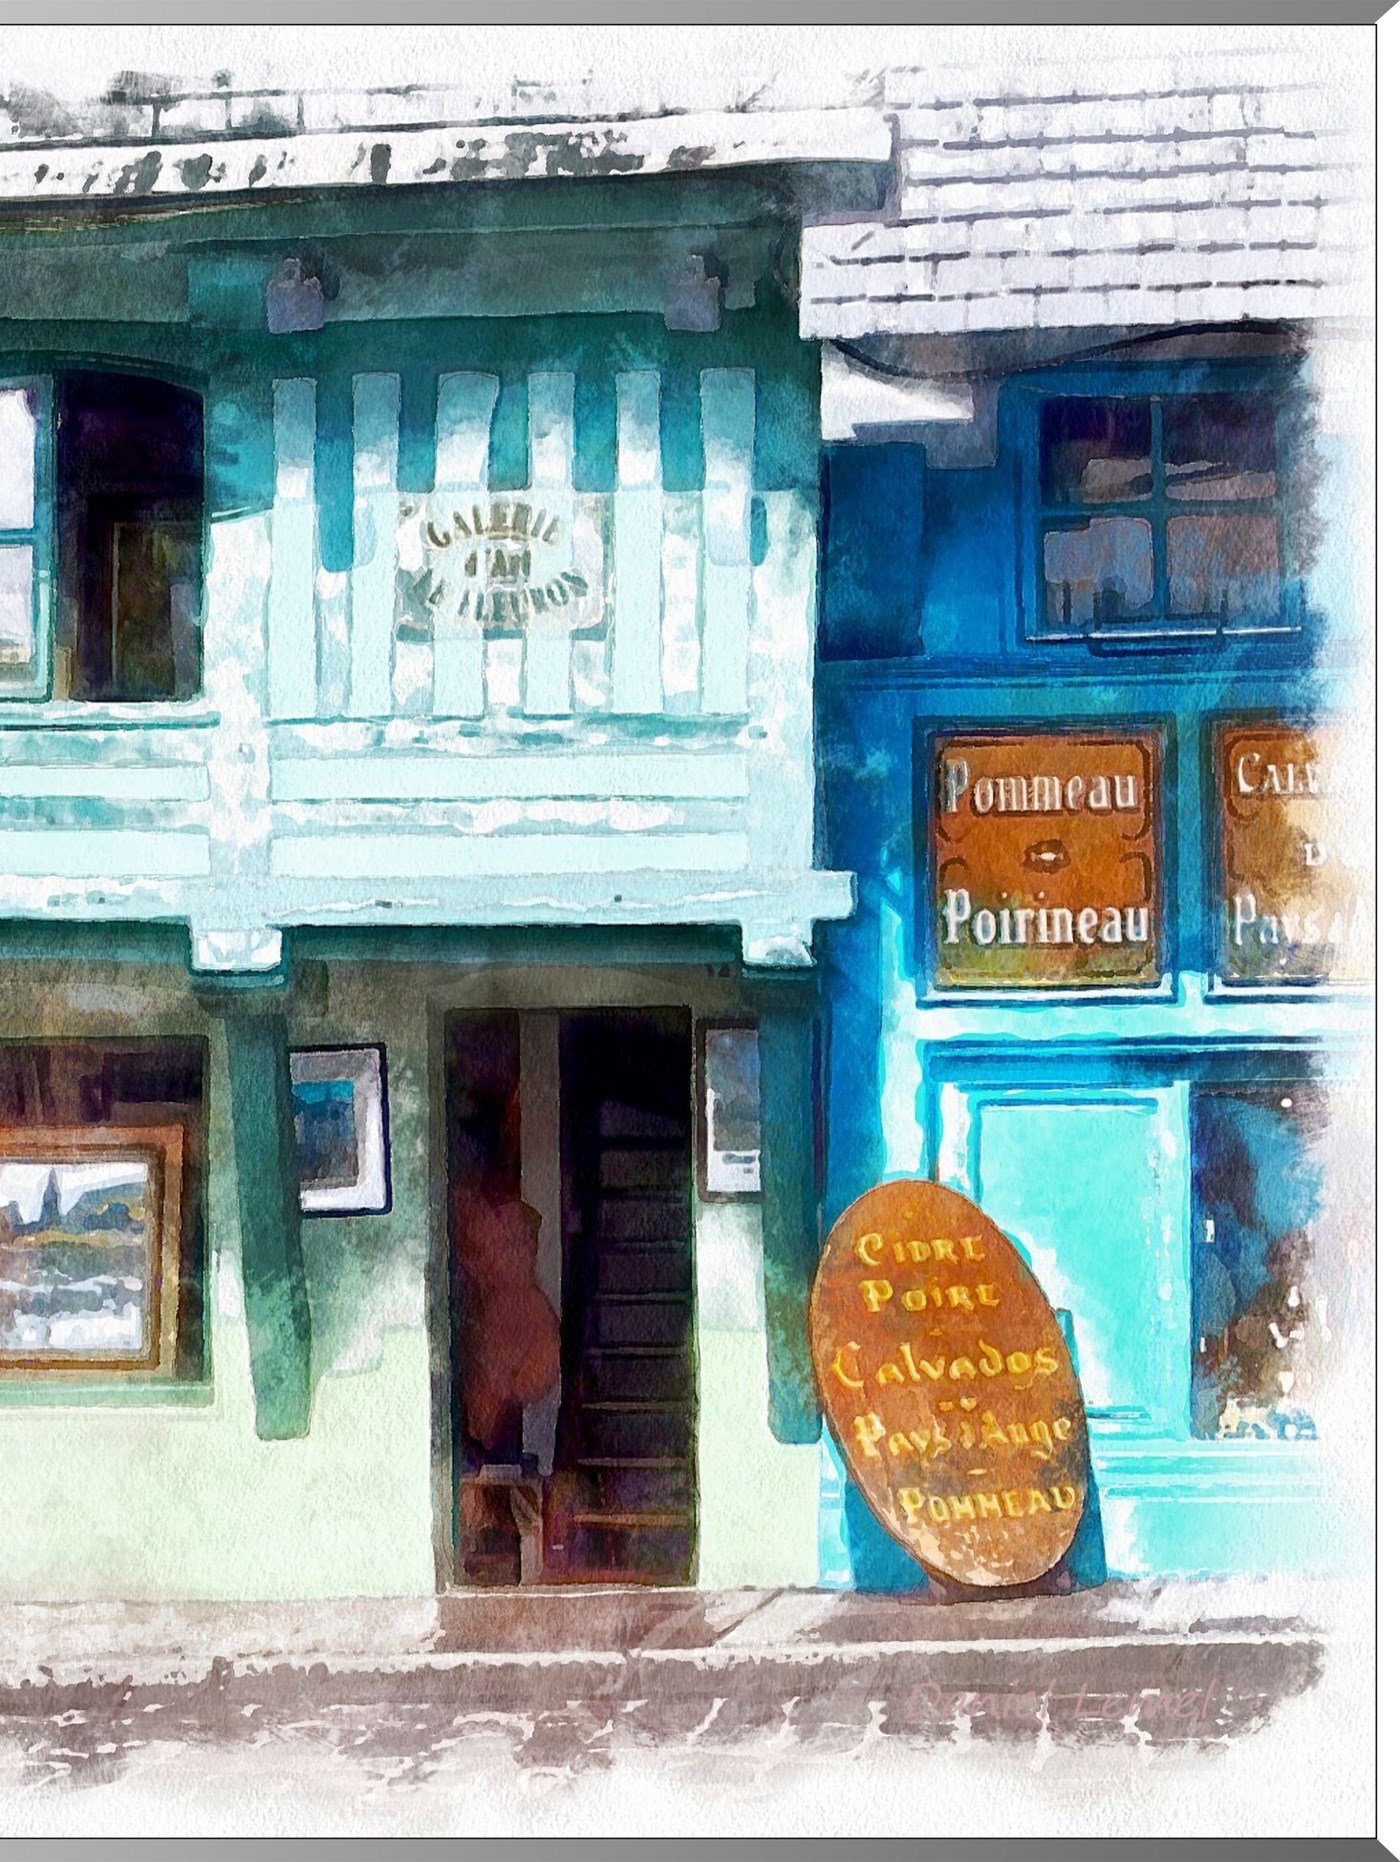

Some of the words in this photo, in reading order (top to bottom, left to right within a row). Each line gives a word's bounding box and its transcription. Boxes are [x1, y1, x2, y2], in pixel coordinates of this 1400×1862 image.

[941, 757, 1138, 813] Pommeau
[942, 887, 1150, 946] Poirineau
[855, 1232, 986, 1267] CIDRE
[831, 1338, 1060, 1391] Calvados
[897, 1486, 1076, 1525] POMMEAU
